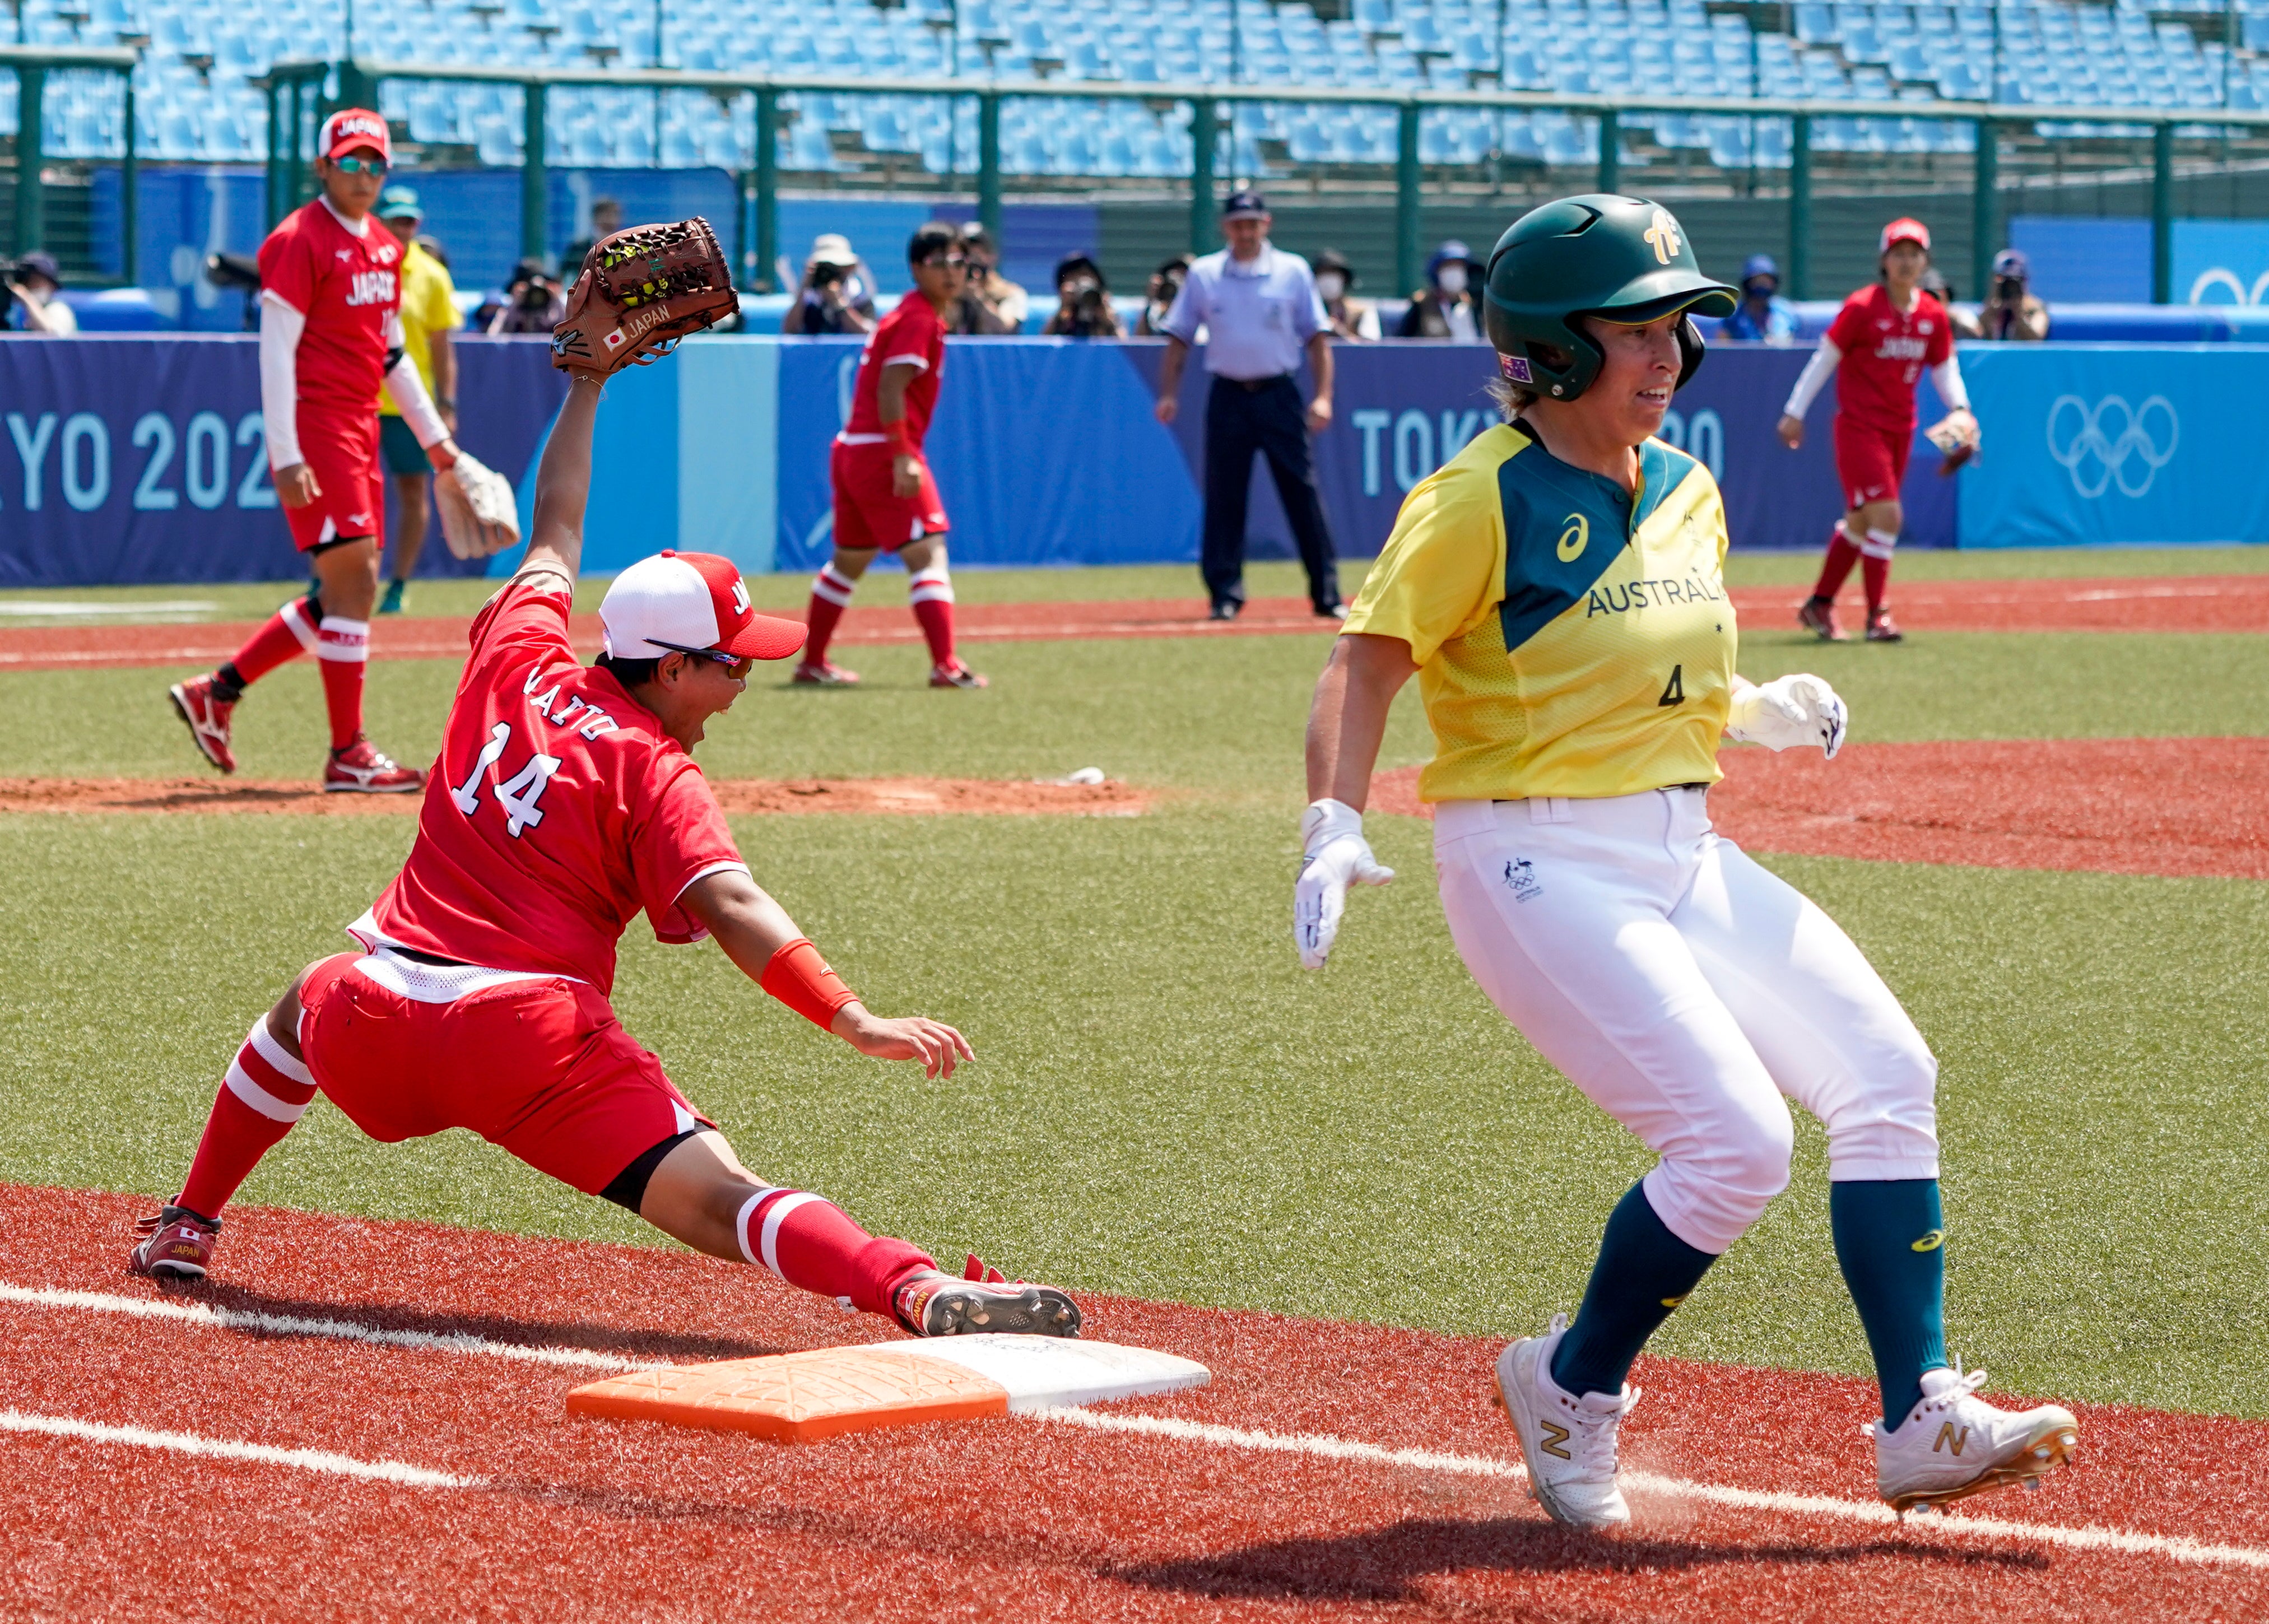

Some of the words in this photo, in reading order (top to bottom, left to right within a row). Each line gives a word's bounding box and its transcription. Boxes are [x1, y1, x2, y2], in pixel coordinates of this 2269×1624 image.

[338, 118, 382, 137] JAPAN
[346, 271, 396, 306] JAPAN
[629, 305, 671, 339] JAPAN
[0, 411, 111, 511] YO
[132, 411, 278, 510] 202
[1351, 409, 1498, 497] TOK
[1658, 664, 1686, 707] 4
[451, 721, 562, 838] 14
[171, 1244, 200, 1258] JAPAN
[913, 1291, 929, 1322] JAPAN
[1932, 1421, 1971, 1457] N
